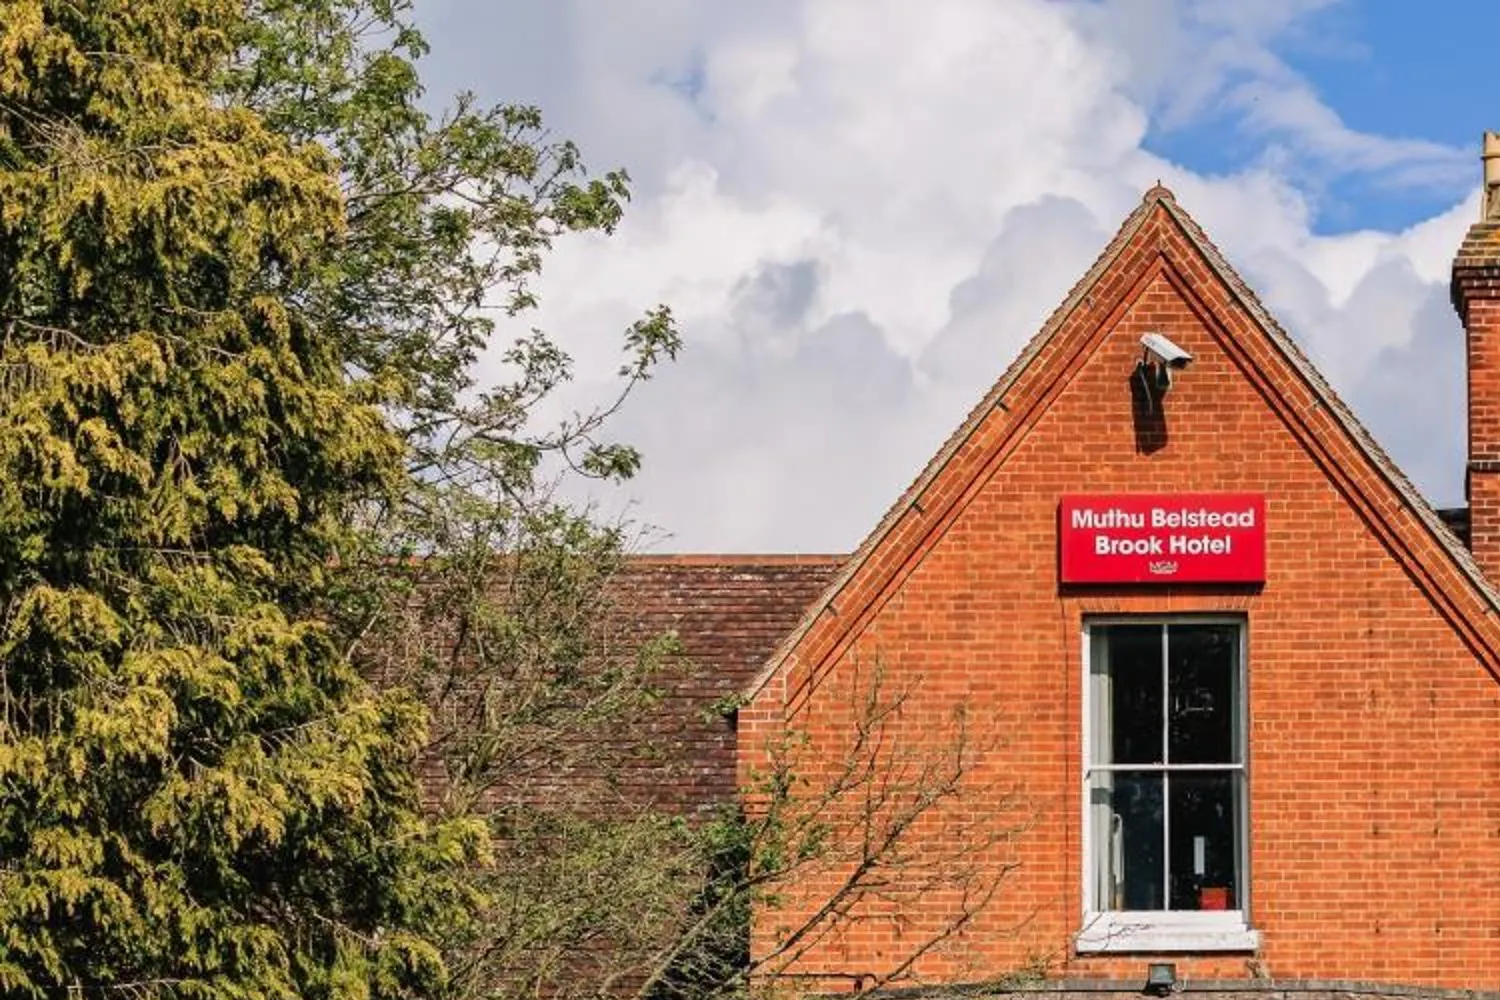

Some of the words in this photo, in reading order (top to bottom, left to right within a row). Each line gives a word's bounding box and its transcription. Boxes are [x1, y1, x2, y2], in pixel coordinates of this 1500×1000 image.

[1071, 508, 1145, 528] Muthu
[1151, 508, 1255, 528] Belstead
[1095, 535, 1163, 555] Brook
[1169, 535, 1231, 555] Hotel
